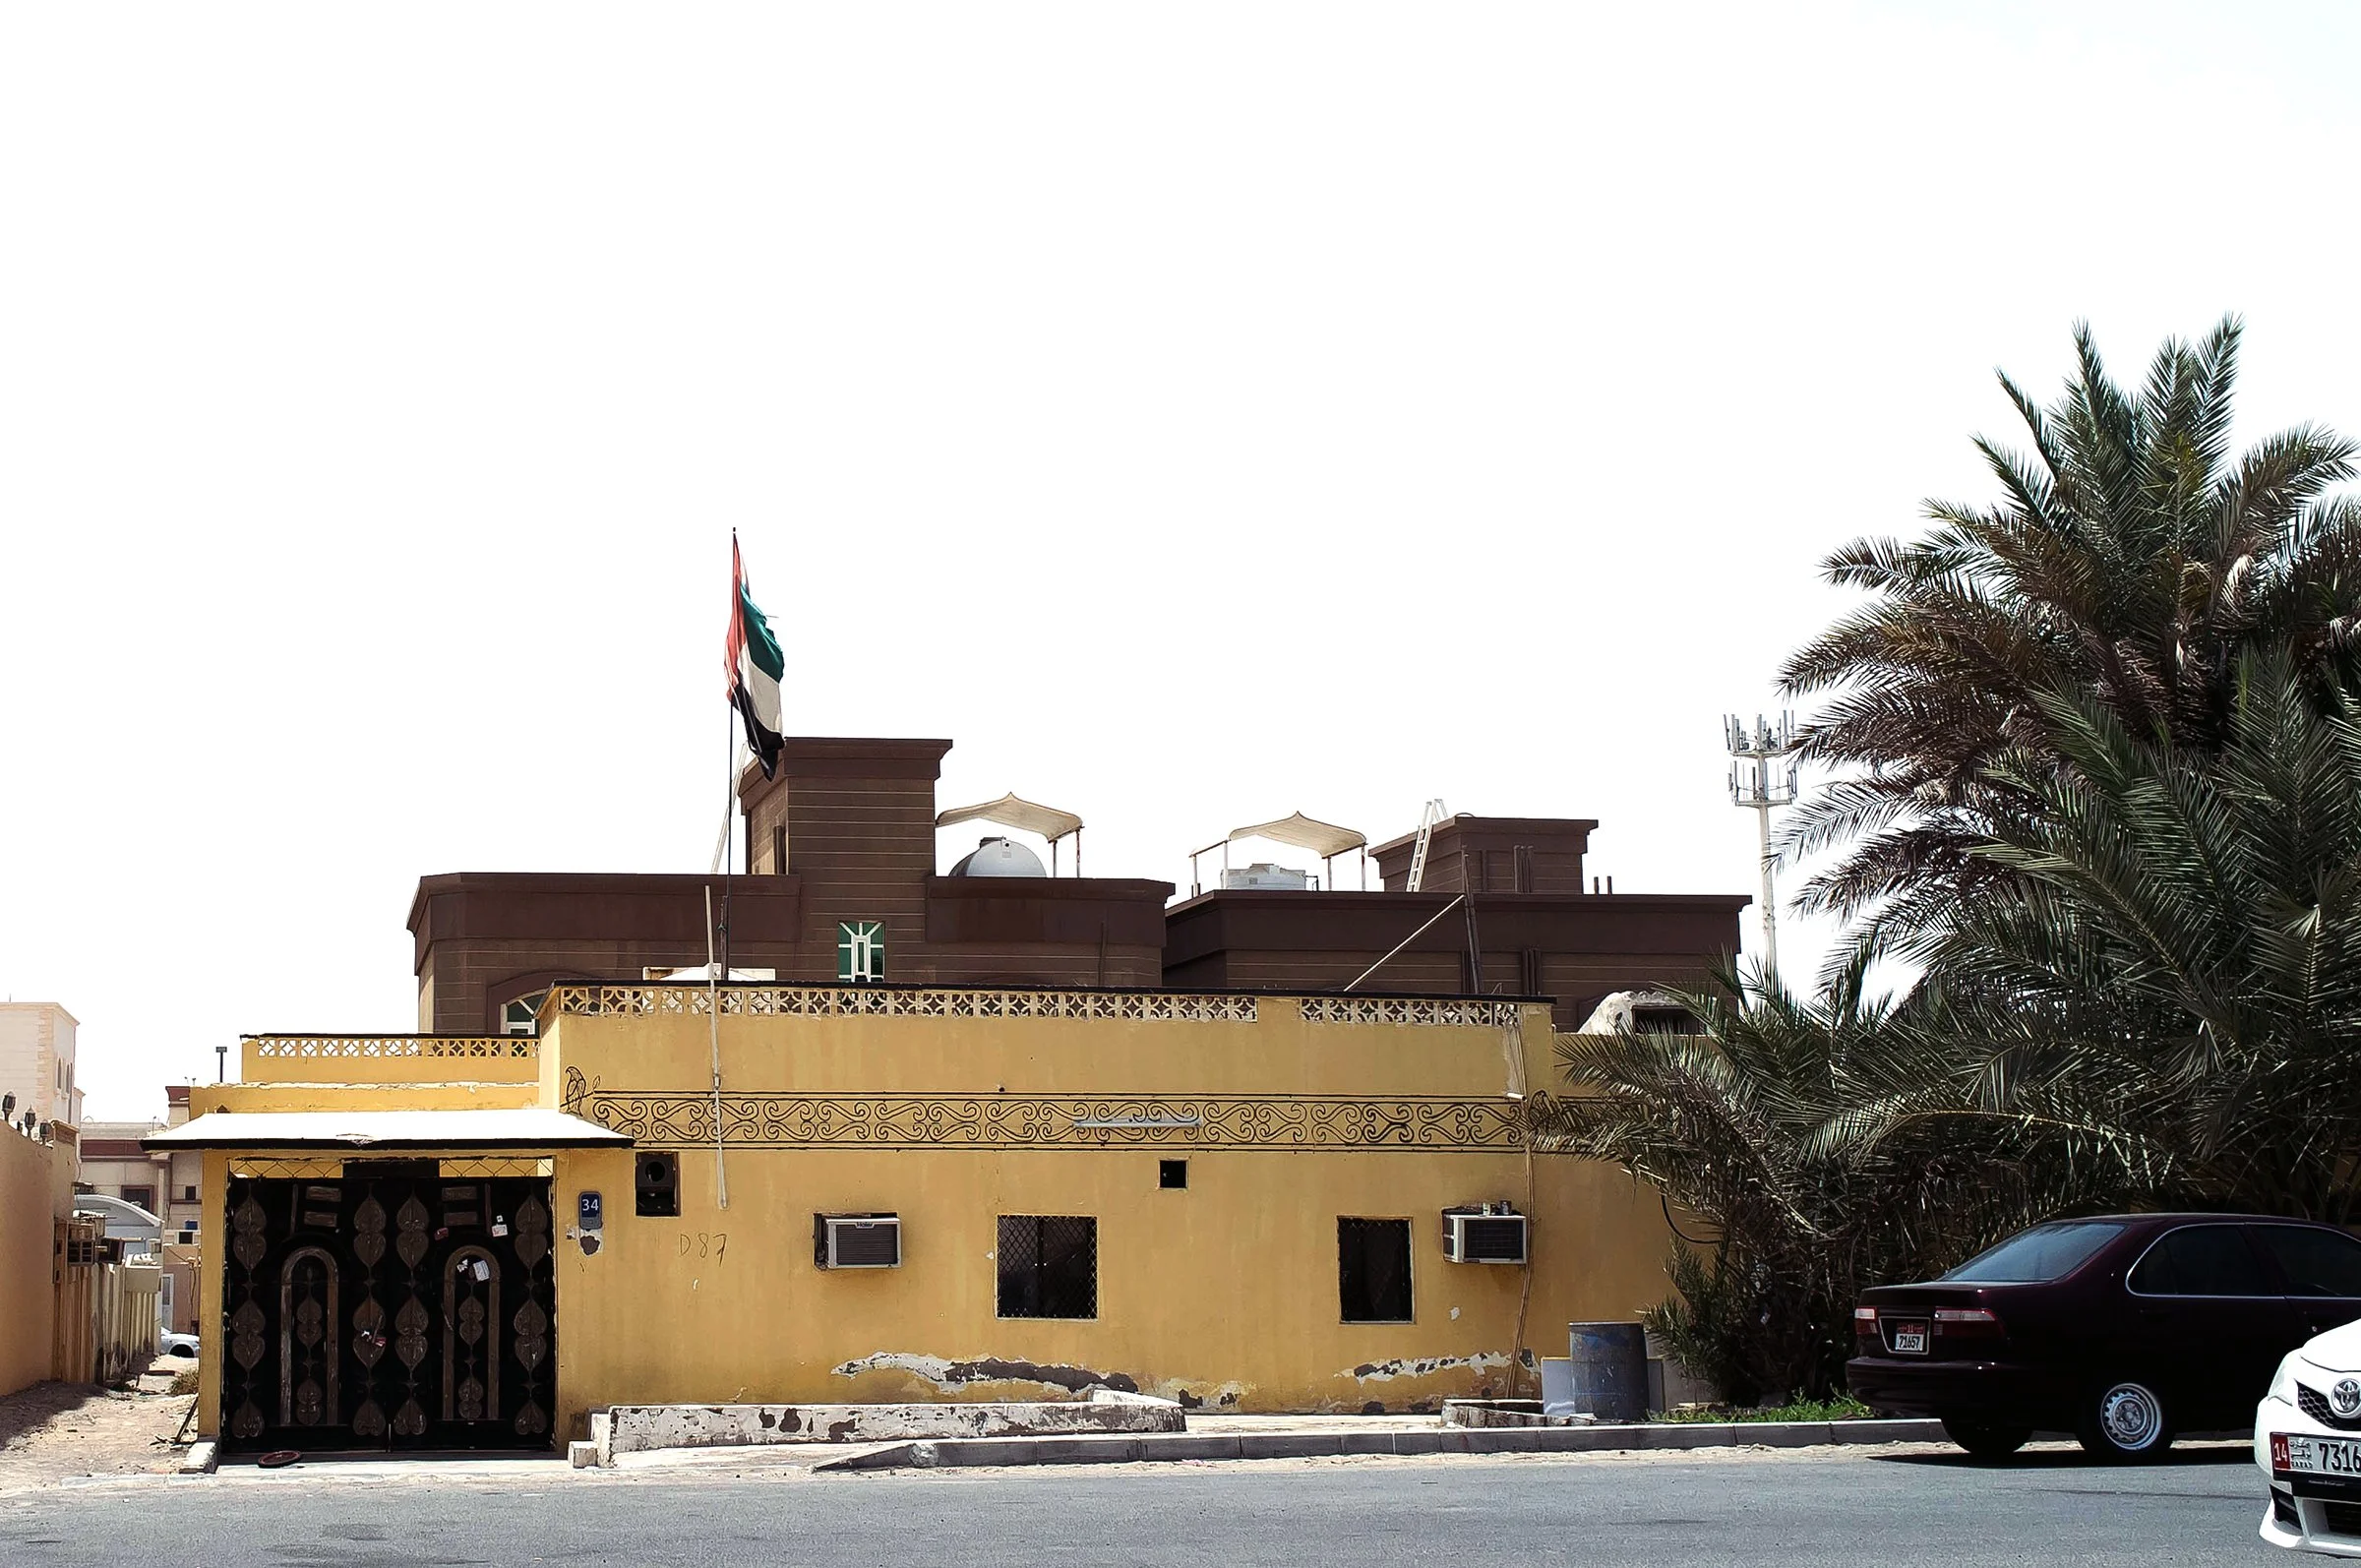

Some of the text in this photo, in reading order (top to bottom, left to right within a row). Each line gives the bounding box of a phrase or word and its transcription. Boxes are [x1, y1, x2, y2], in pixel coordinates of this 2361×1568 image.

[581, 1198, 599, 1211] 34
[2273, 1442, 2288, 1462] 14
[2318, 1442, 2361, 1473] 7316
